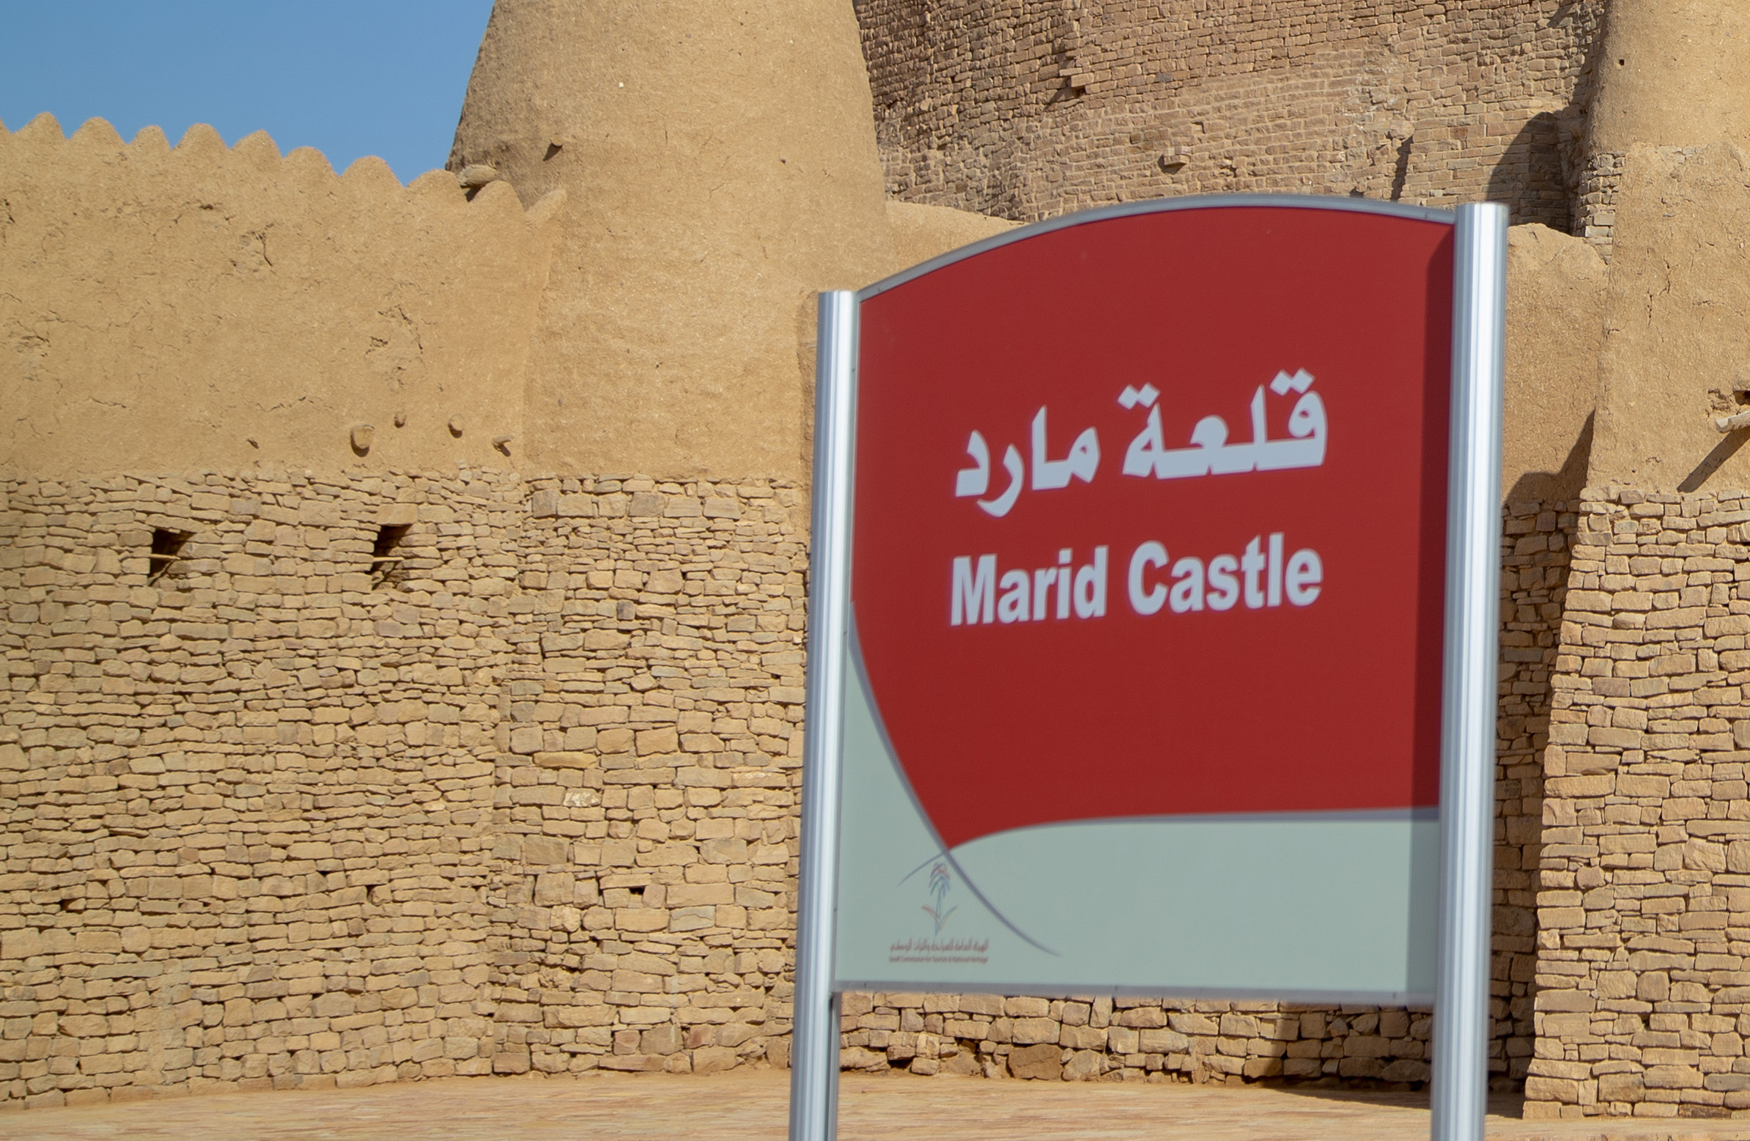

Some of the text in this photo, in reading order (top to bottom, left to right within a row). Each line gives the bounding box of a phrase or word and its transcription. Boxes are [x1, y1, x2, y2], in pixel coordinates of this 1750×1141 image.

[954, 367, 1329, 518] قلعة مارد
[949, 532, 1324, 626] Marid Castle
